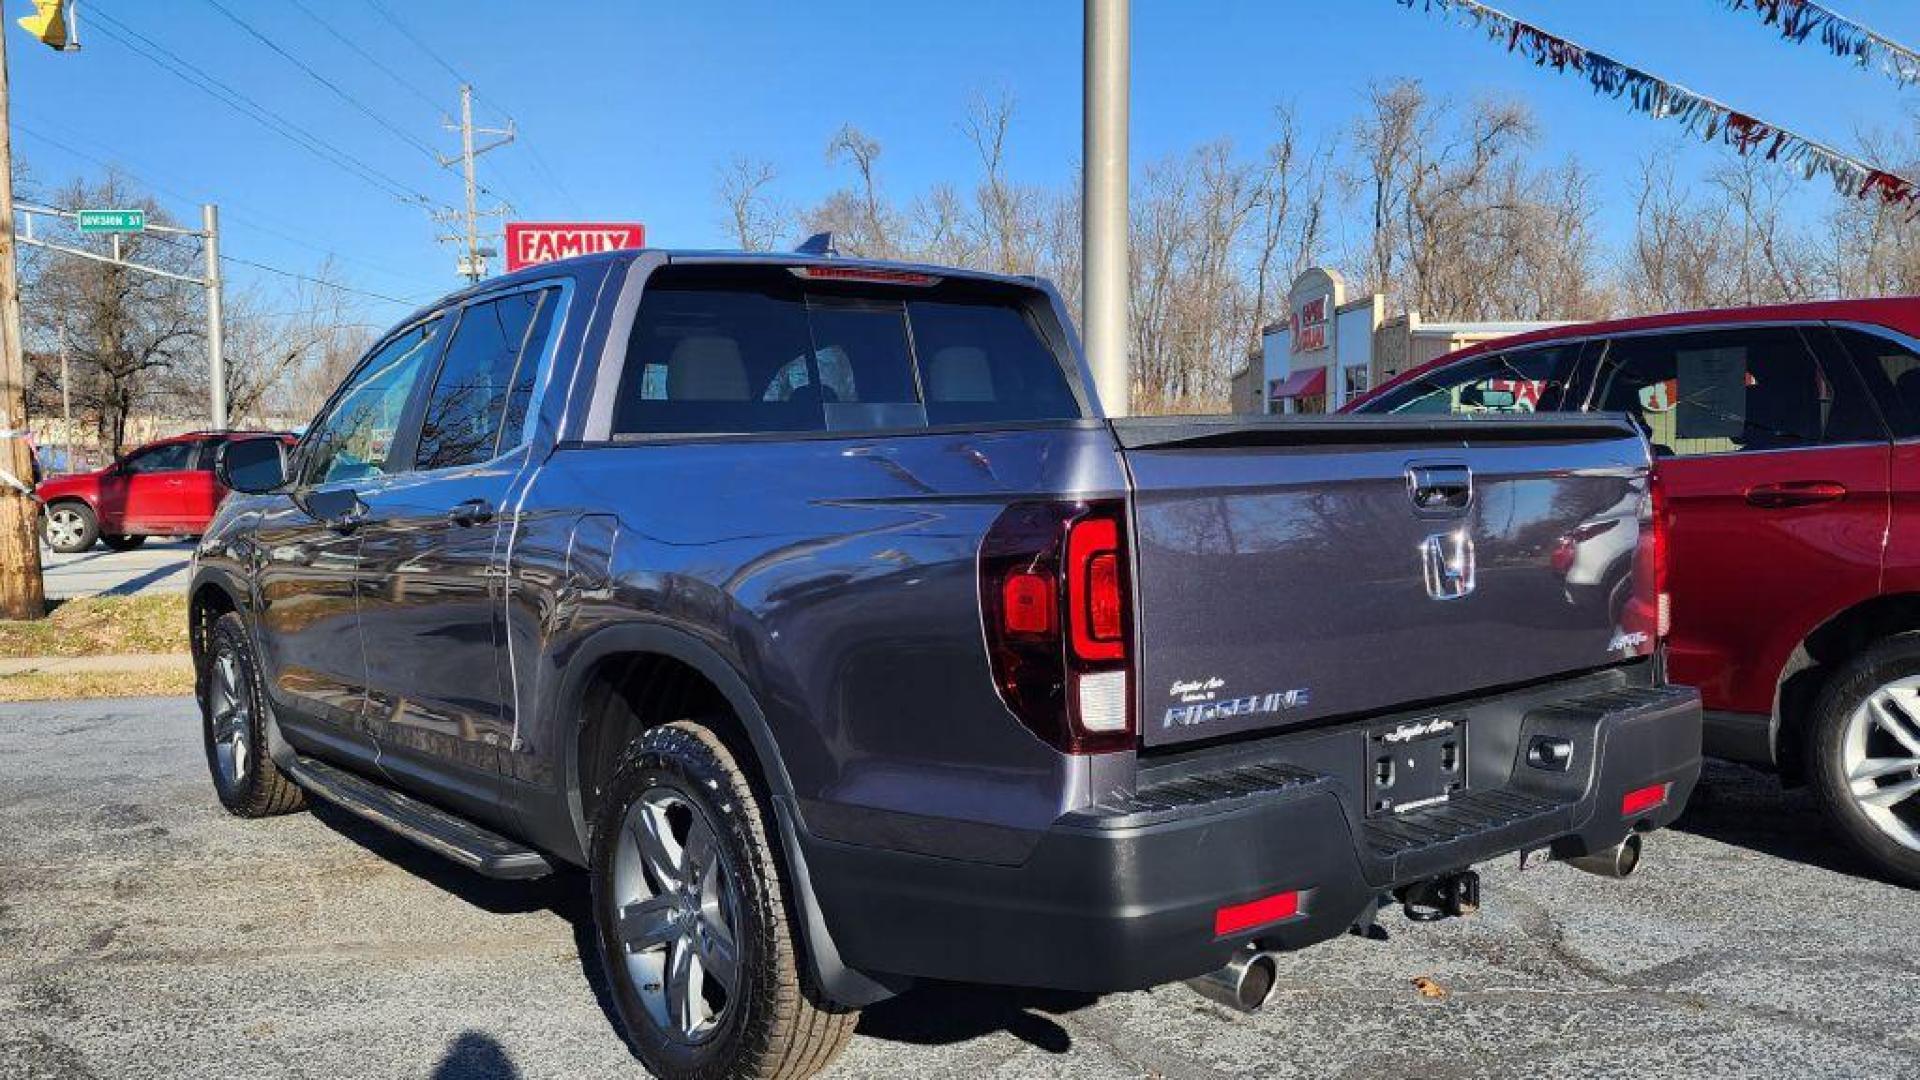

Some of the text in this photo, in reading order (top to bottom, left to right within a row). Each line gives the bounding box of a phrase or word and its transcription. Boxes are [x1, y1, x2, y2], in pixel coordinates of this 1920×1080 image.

[82, 214, 140, 226] DIVISION ST
[518, 230, 630, 263] FAMILY
[1163, 688, 1313, 728] RIDGELINE
